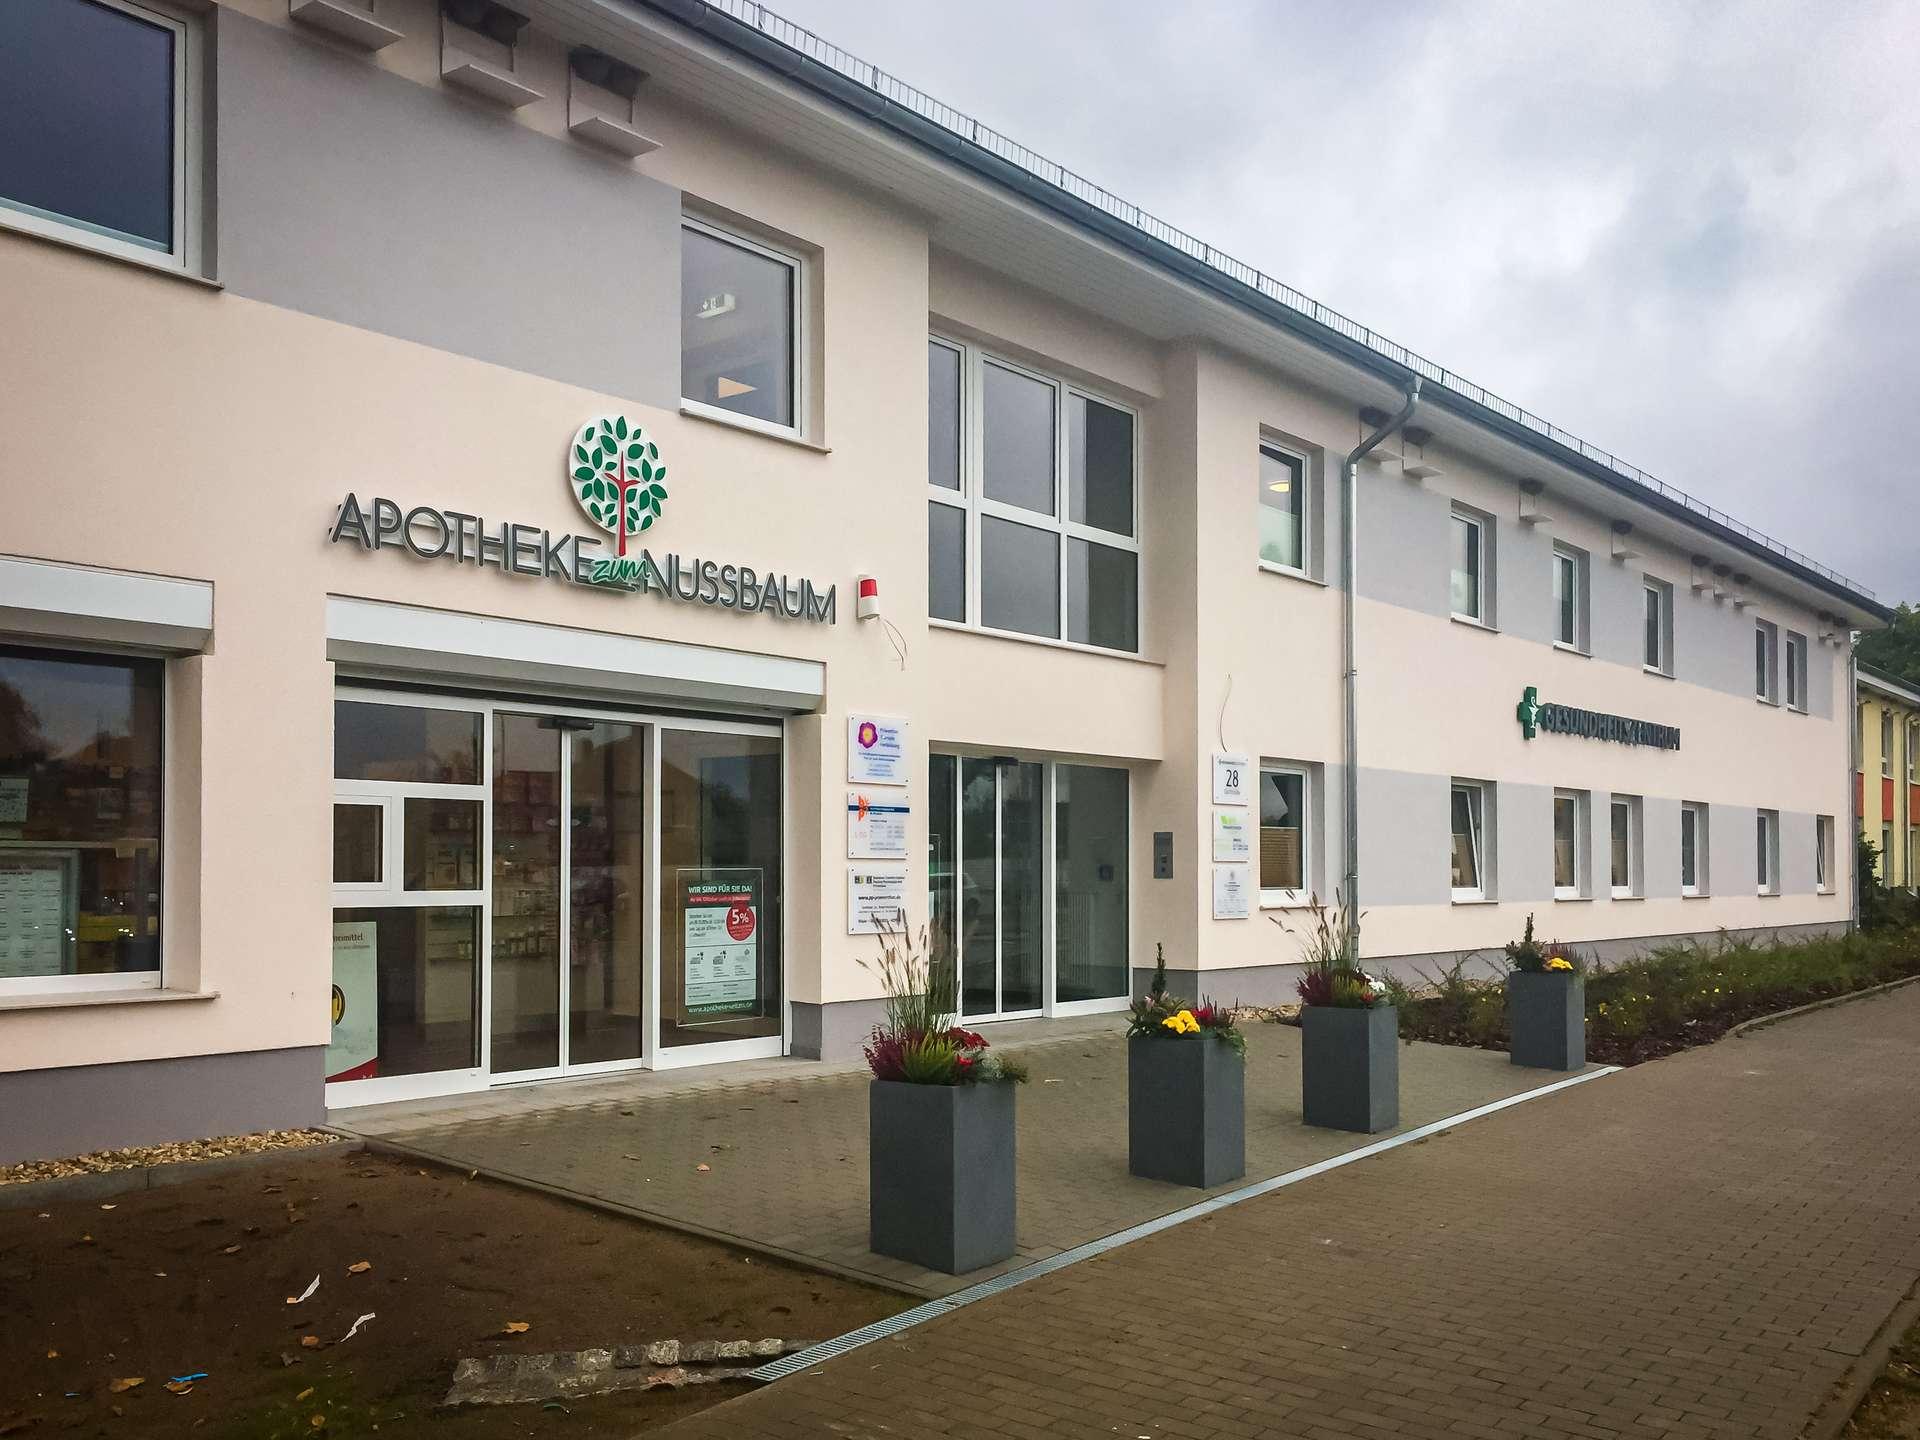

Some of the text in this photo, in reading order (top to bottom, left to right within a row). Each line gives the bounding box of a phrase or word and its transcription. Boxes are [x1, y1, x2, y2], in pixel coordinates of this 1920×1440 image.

[329, 492, 836, 625] APOTHEKE zum NUSSBAUM
[1544, 703, 1680, 751] GESUNDHEITSZENTRUM
[1225, 769, 1239, 788] 28
[688, 886, 701, 894] WIR
[718, 884, 730, 893] FÜR
